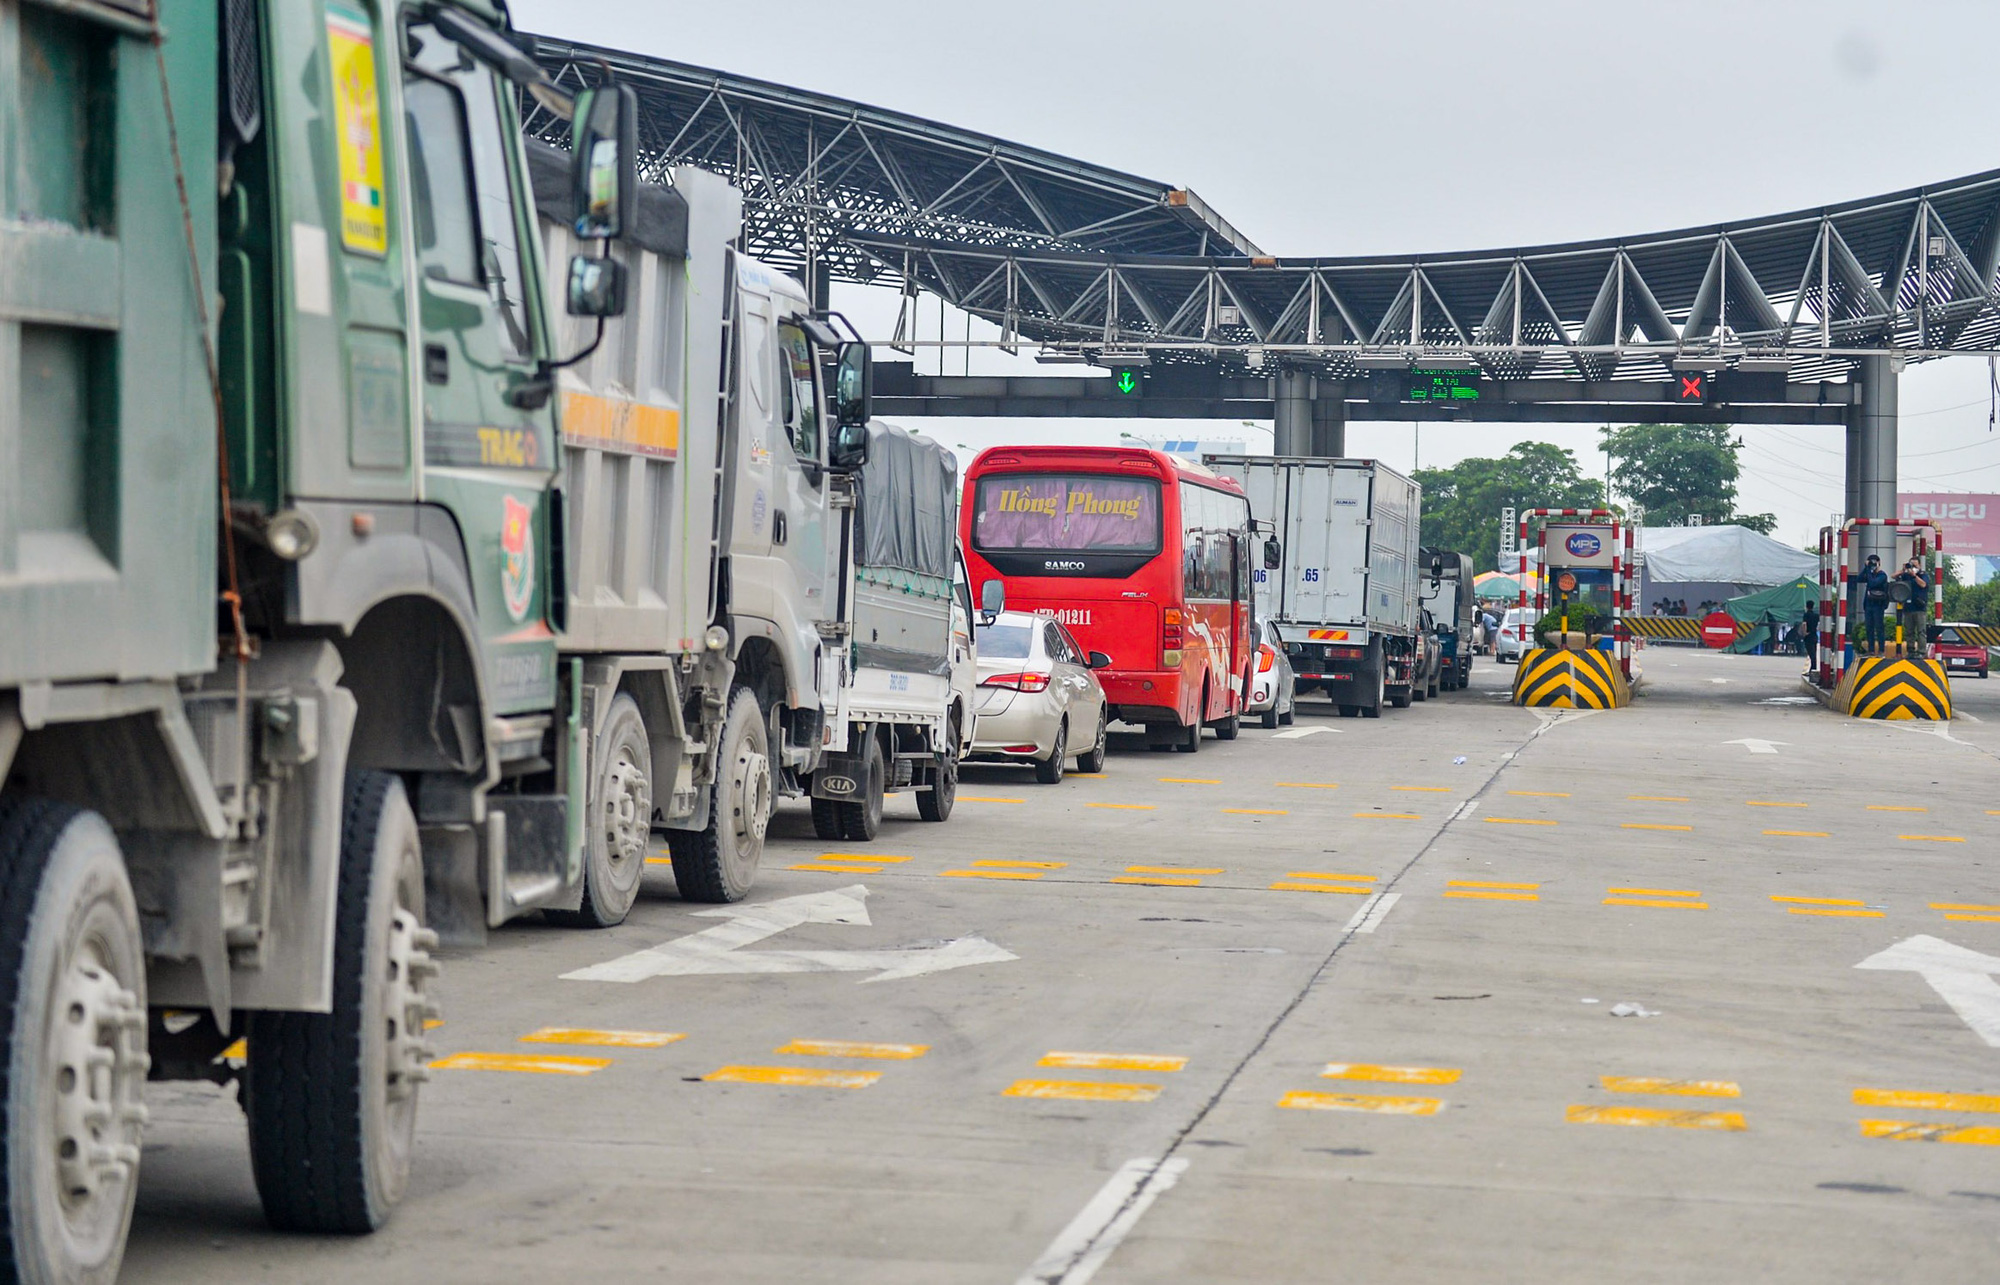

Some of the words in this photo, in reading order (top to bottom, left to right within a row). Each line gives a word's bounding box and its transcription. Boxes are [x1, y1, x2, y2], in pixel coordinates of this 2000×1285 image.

[477, 427, 538, 467] TRAGO
[999, 485, 1059, 518] Hồng
[1065, 492, 1142, 521] Phong
[1902, 502, 1987, 519] ISUZU
[1570, 539, 1599, 549] MPC
[1044, 561, 1086, 571] SAMCO
[827, 778, 851, 790] KIA
